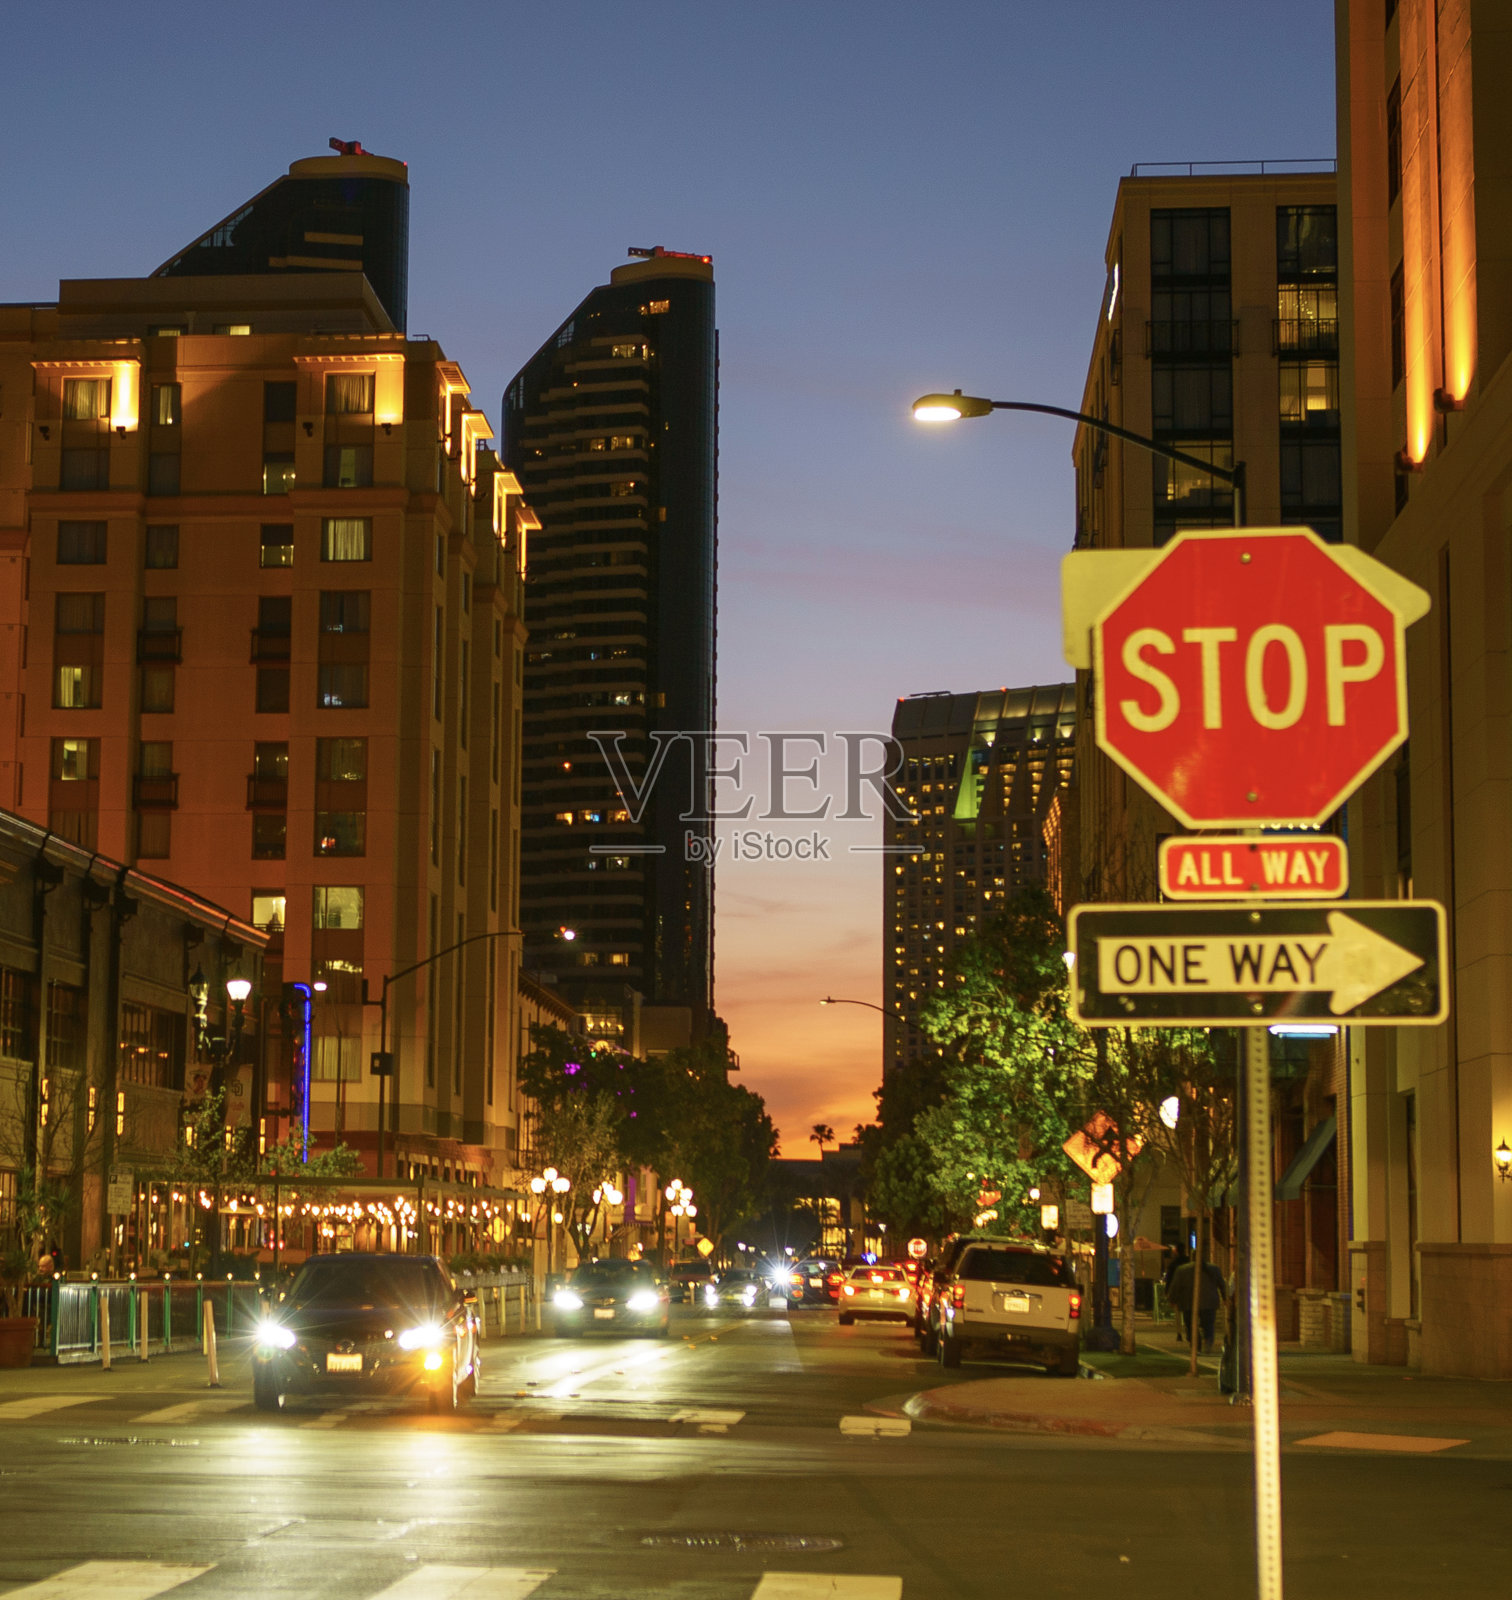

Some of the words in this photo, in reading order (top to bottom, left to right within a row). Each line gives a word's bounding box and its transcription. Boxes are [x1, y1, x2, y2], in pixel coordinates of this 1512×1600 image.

[1120, 624, 1385, 732] STOP
[1177, 851, 1243, 885] ALL
[1261, 849, 1329, 884] WAY
[1114, 944, 1208, 985] ONE
[1229, 943, 1328, 984] WAY
